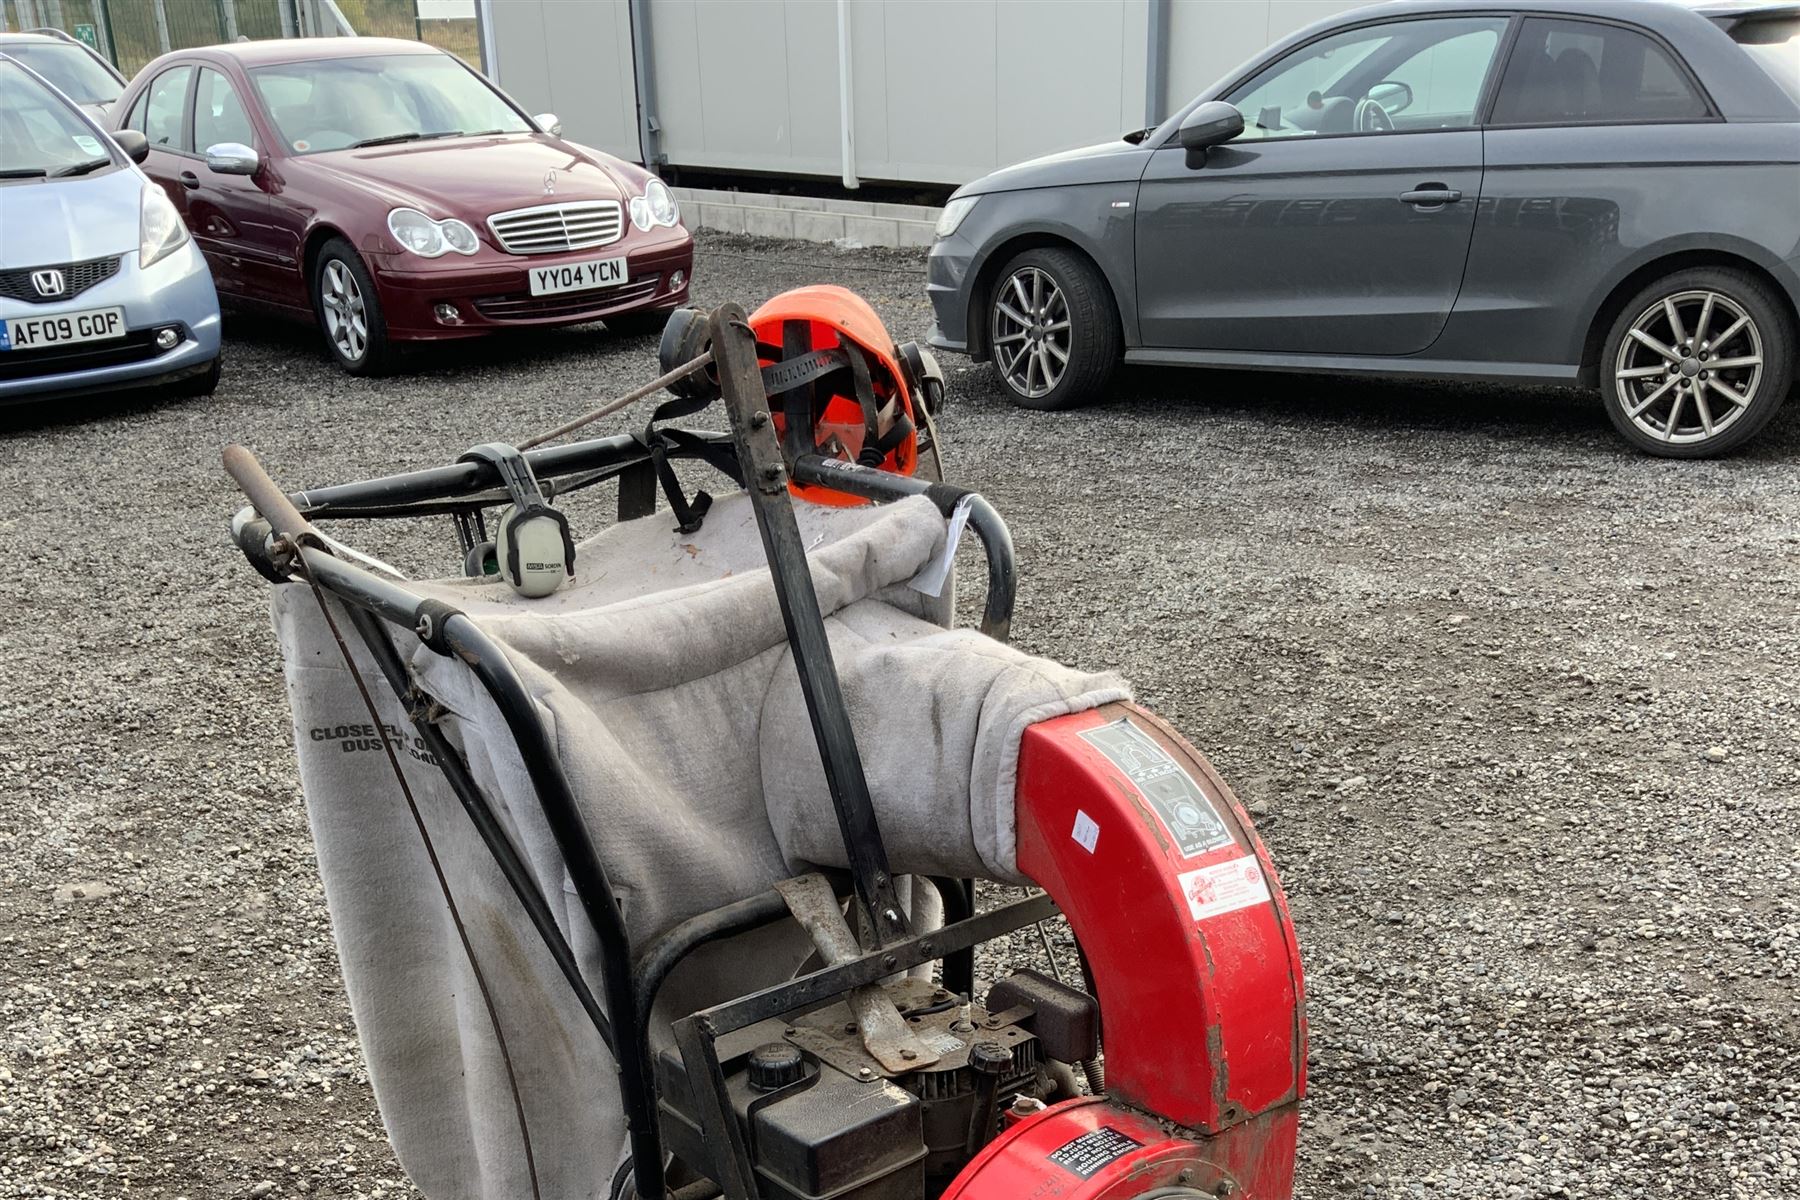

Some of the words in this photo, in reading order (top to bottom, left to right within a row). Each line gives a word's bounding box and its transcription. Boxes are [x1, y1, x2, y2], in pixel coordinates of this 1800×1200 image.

[537, 266, 583, 290] YY04
[588, 260, 620, 283] YCN
[15, 318, 73, 345] AF09
[310, 724, 375, 741] CLOSE
[341, 738, 404, 753] DUSY
[1051, 1150, 1062, 1159] DO
[1062, 1142, 1076, 1152] NOT
[1075, 1132, 1094, 1146] MAKE
[1063, 1146, 1093, 1165] REMOVE
[1093, 1134, 1121, 1148] NOZZLE
[1075, 1150, 1109, 1172] HOUSING
[1110, 1140, 1134, 1152] WHILE
[1079, 1153, 1091, 1162] OR
[1091, 1141, 1119, 1155] ROTATE
[1081, 1154, 1113, 1176] RUNNING
